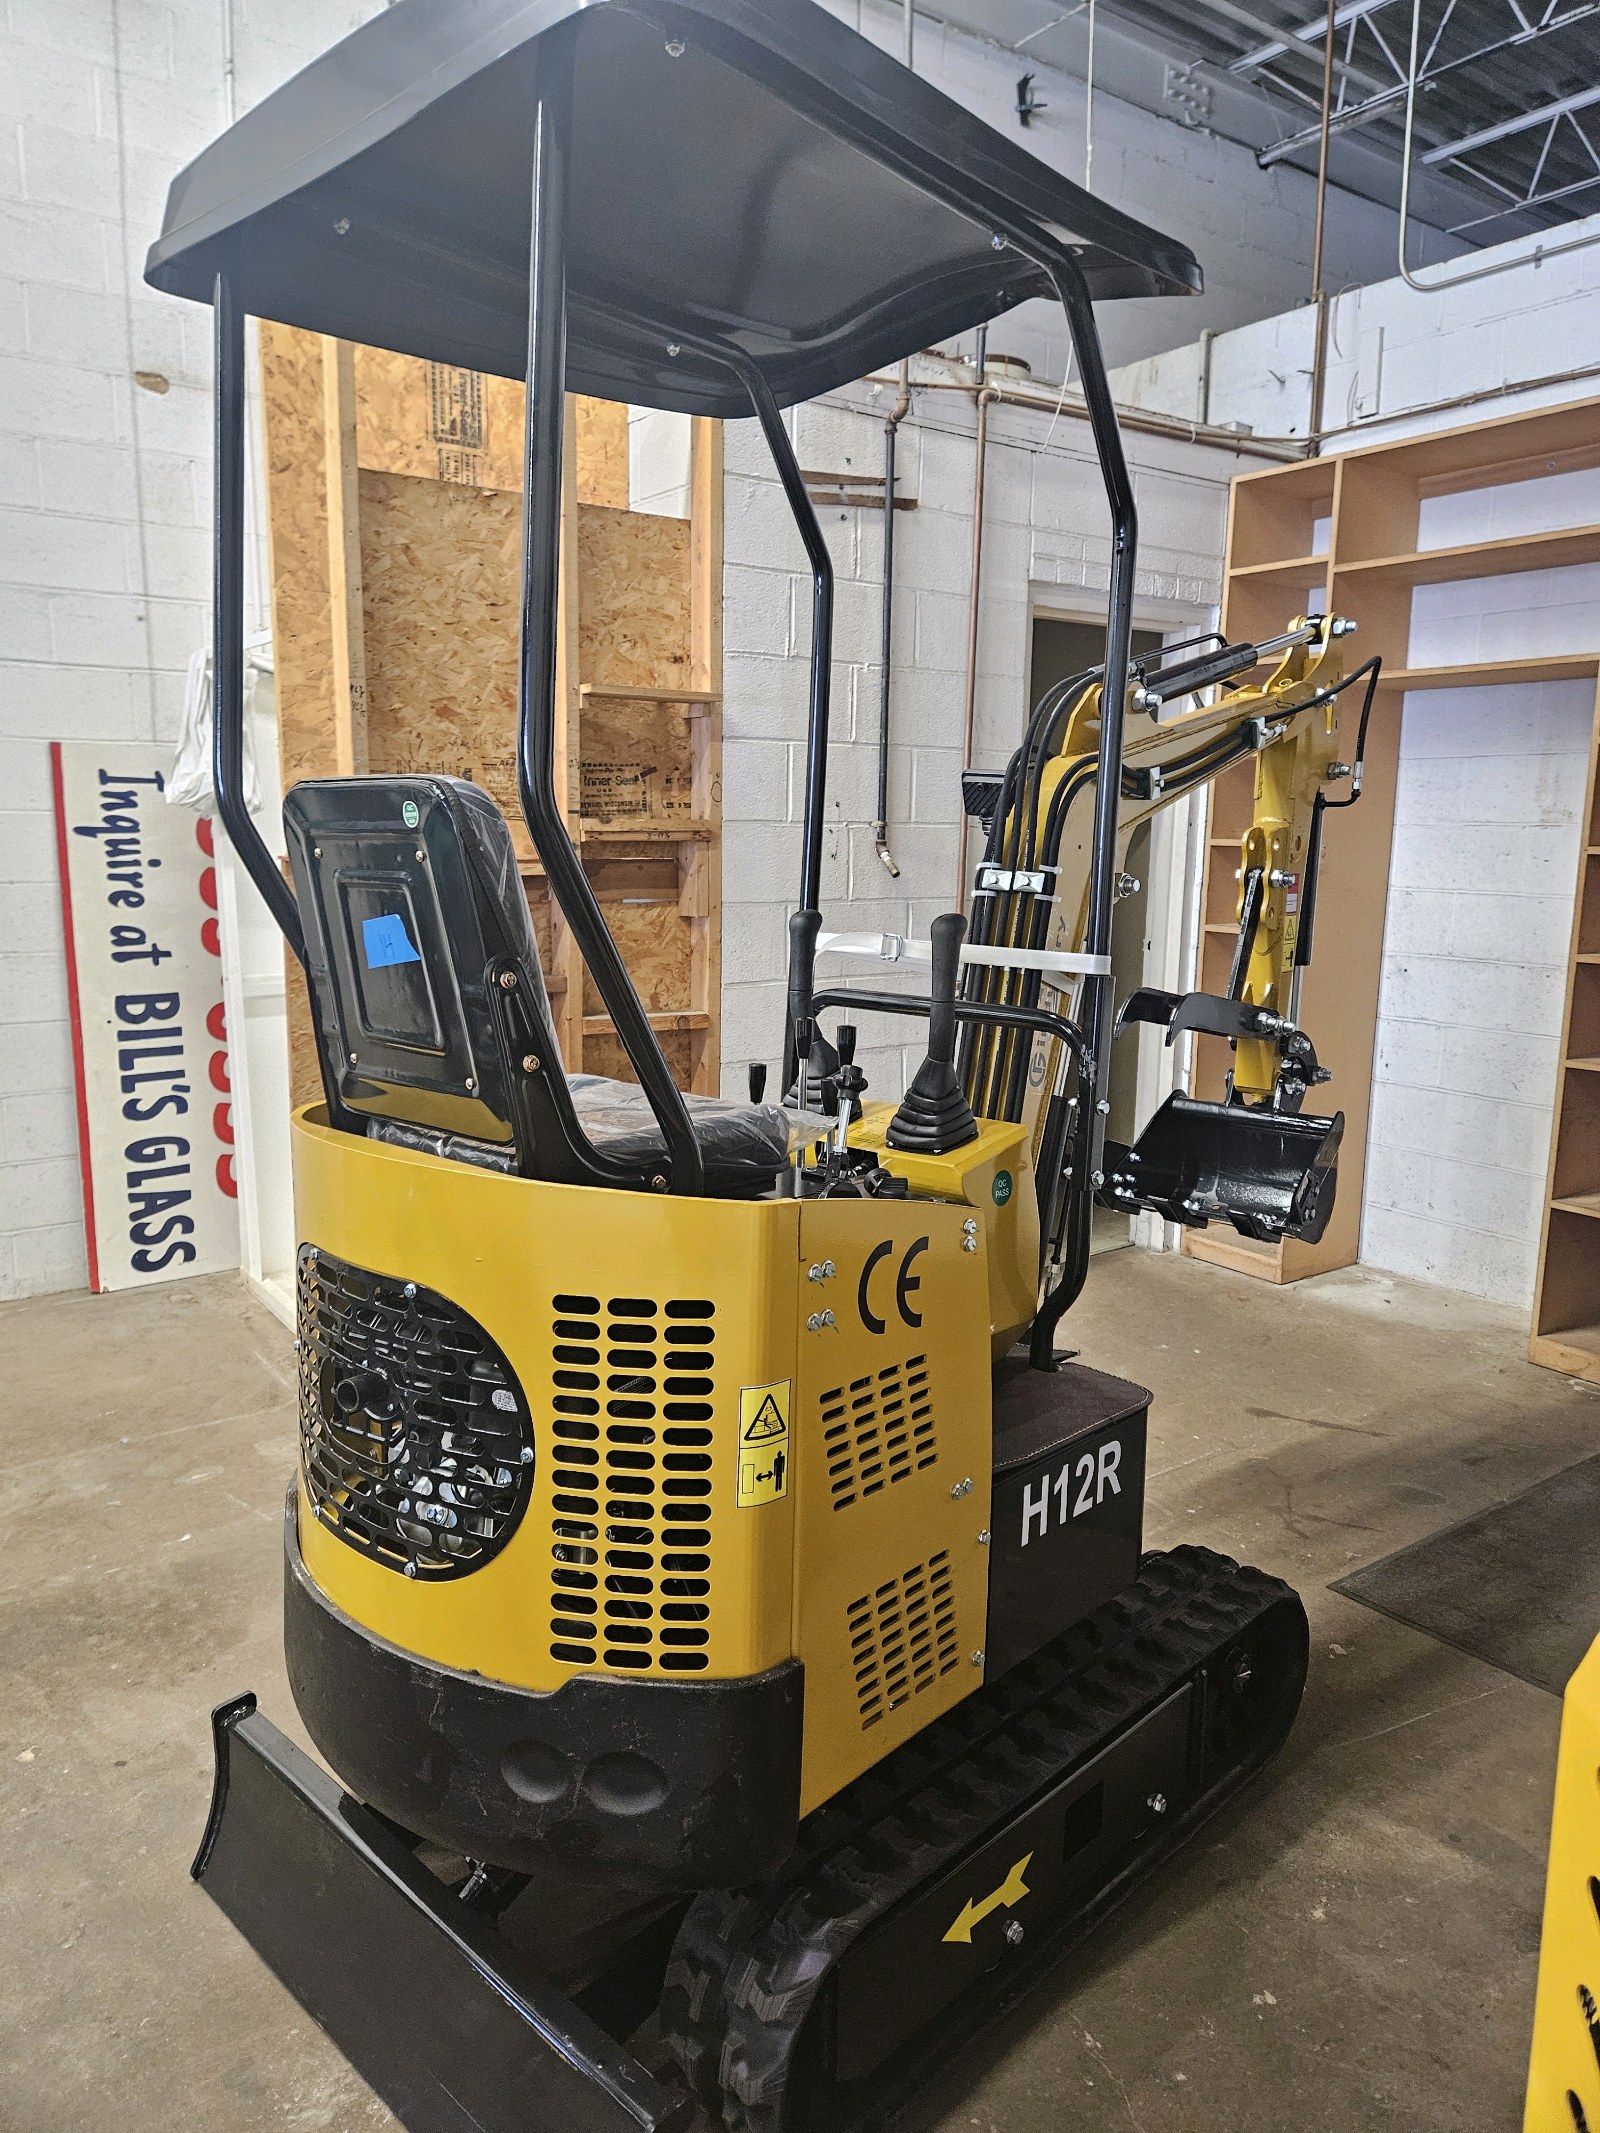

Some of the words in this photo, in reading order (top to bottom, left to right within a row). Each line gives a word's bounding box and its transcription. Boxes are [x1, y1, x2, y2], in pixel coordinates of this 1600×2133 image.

[72, 768, 165, 909] Inquire
[109, 925, 173, 967] at
[114, 991, 190, 1122] BILL'S
[124, 1136, 197, 1273] GLASS
[995, 1188, 1009, 1198] PASS
[997, 1179, 1007, 1188] QC
[857, 1236, 930, 1335] CE
[1021, 1440, 1122, 1547] H12R
